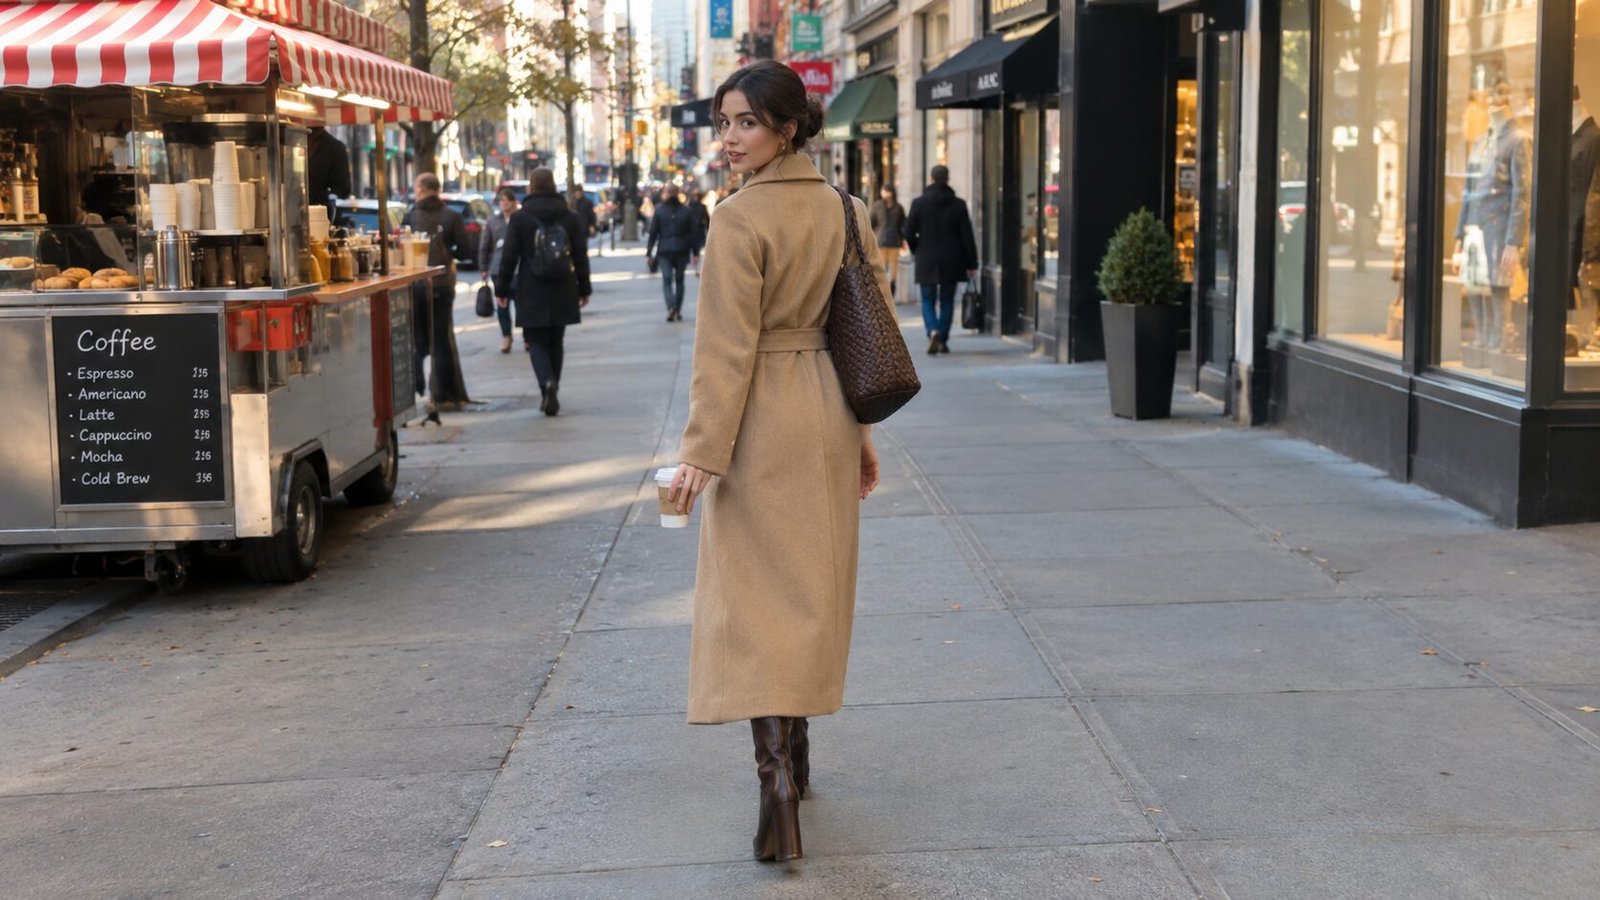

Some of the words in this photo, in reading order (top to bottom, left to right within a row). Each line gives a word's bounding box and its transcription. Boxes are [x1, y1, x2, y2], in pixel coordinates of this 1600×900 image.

[77, 328, 157, 358] Coffee
[77, 366, 135, 383] Espresso
[77, 387, 147, 401] Americano
[79, 408, 116, 421] Latte
[79, 428, 153, 445] Cappuccino
[80, 449, 124, 463] Mocha
[81, 471, 111, 486] Cold
[116, 471, 151, 485] Brew
